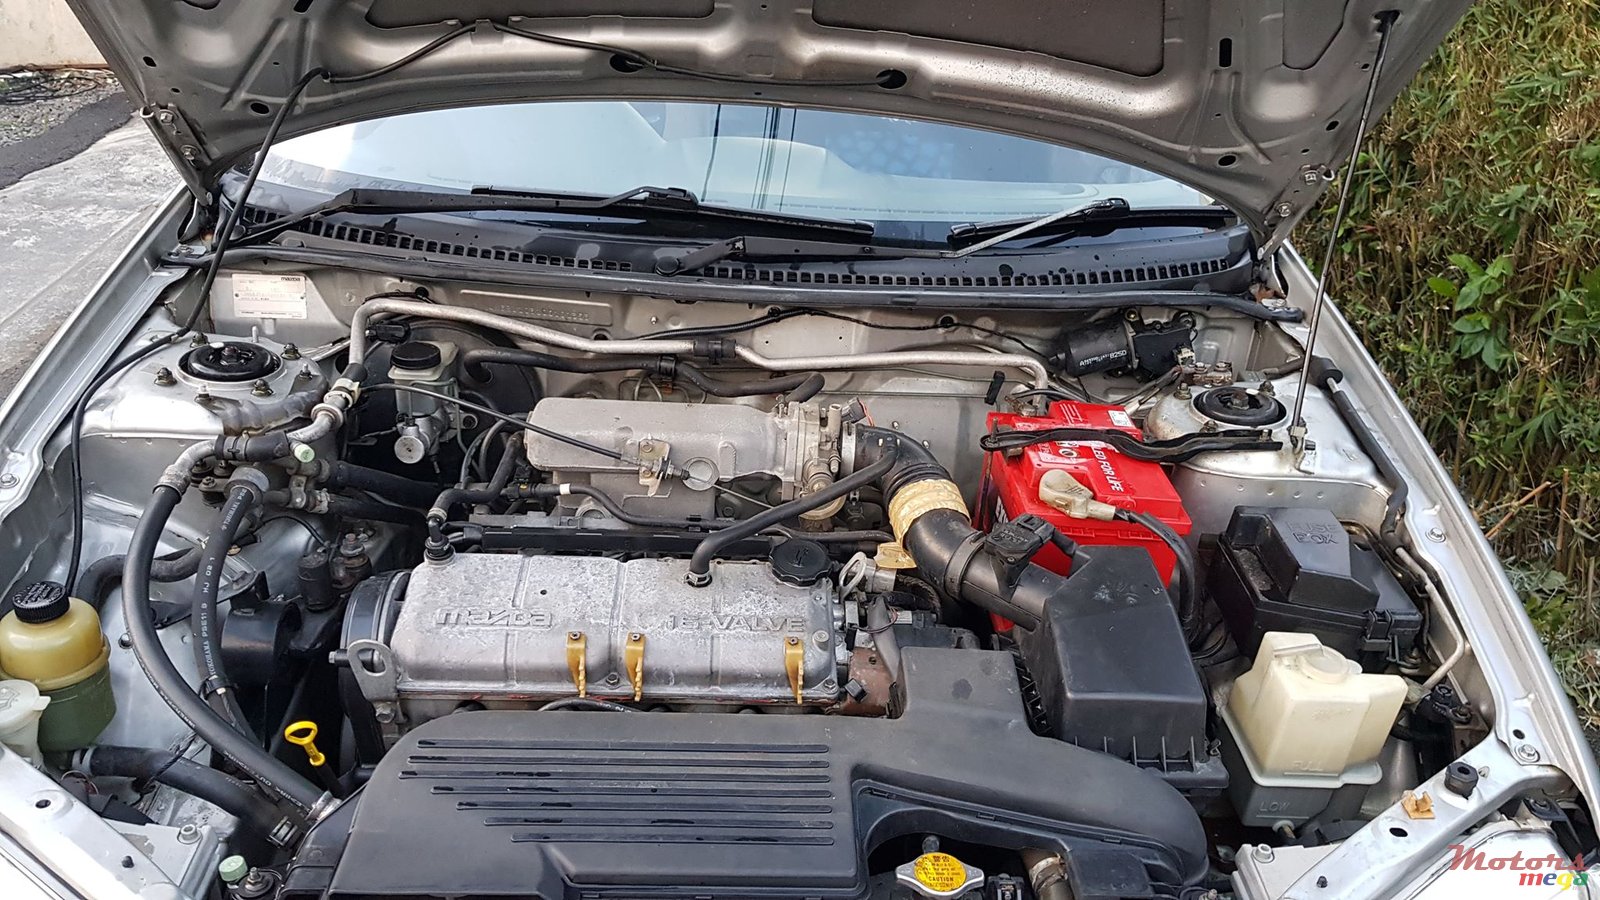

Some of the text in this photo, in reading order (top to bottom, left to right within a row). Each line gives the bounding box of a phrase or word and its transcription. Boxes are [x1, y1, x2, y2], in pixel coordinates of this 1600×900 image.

[1293, 532, 1339, 544] BOX
[435, 607, 552, 627] mazda
[1260, 801, 1290, 812] LOW
